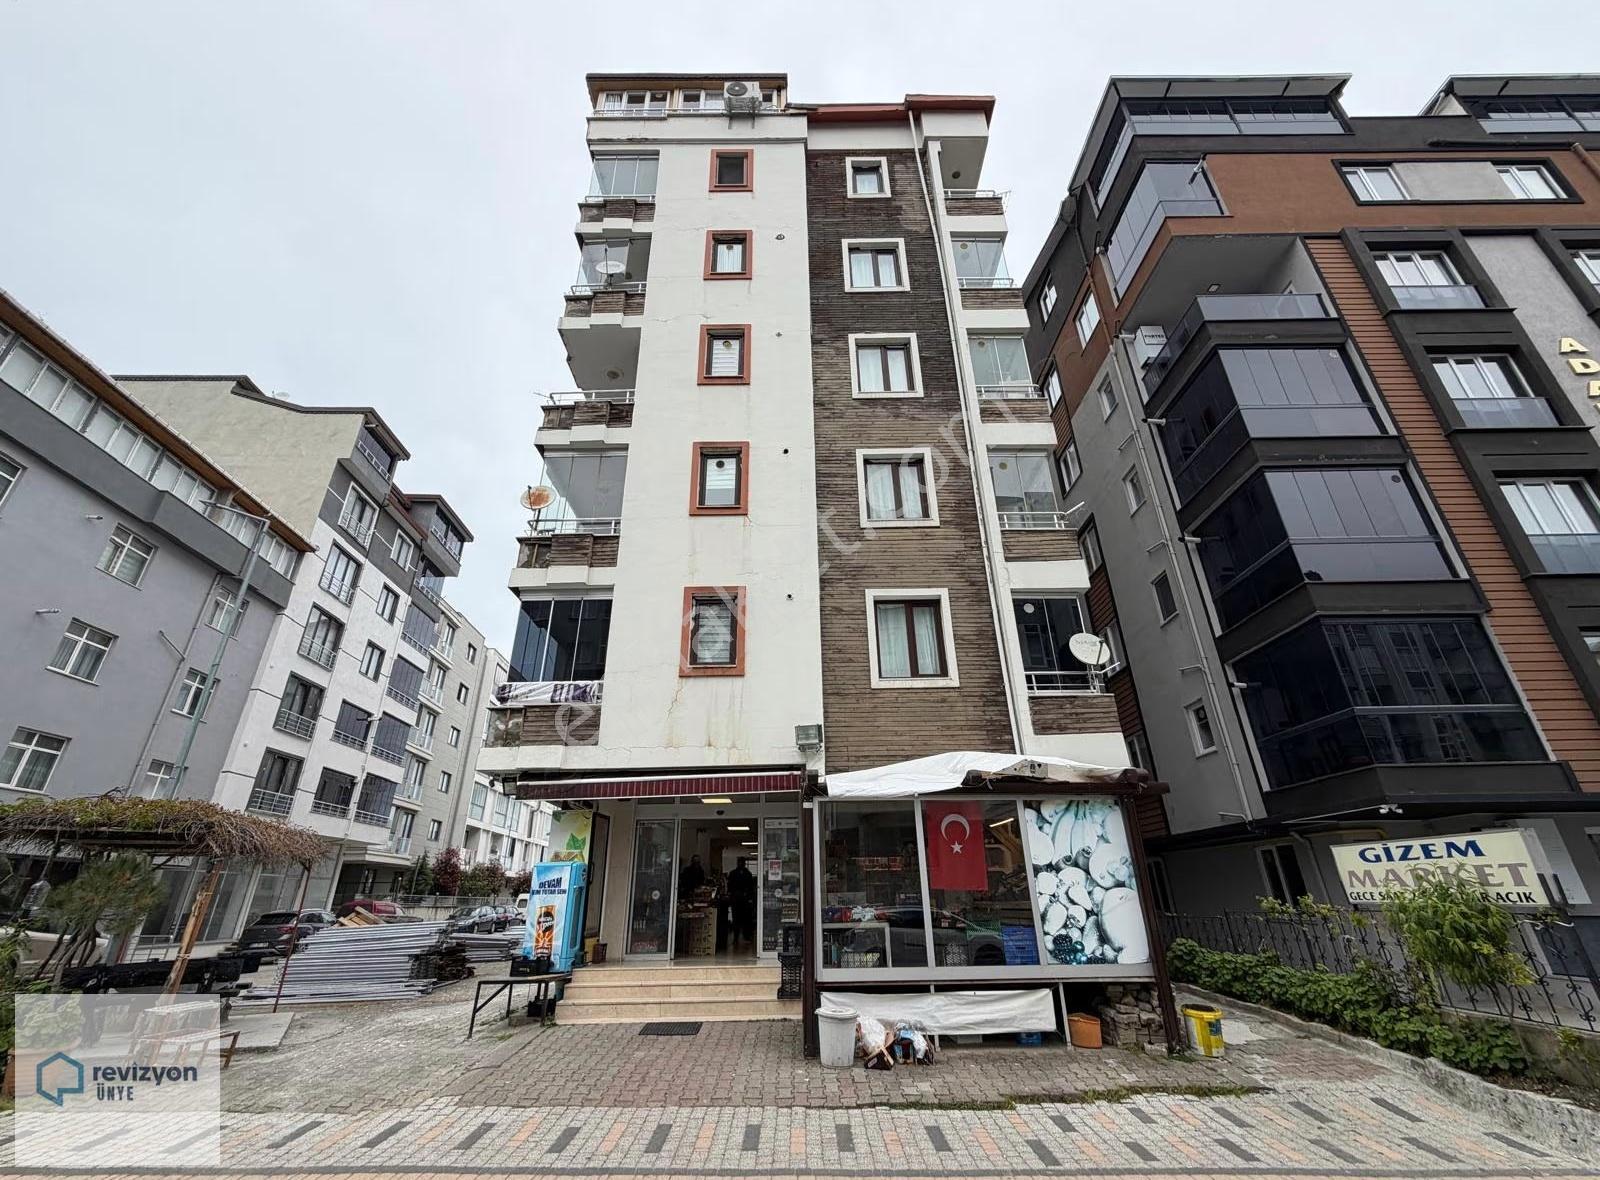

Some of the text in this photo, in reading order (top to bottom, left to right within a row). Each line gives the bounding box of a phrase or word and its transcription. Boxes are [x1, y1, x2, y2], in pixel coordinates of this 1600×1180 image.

[1358, 839, 1486, 863] GİZEM
[538, 877, 562, 888] DEVAM
[1347, 862, 1528, 889] MARKET
[1349, 891, 1377, 901] GECE
